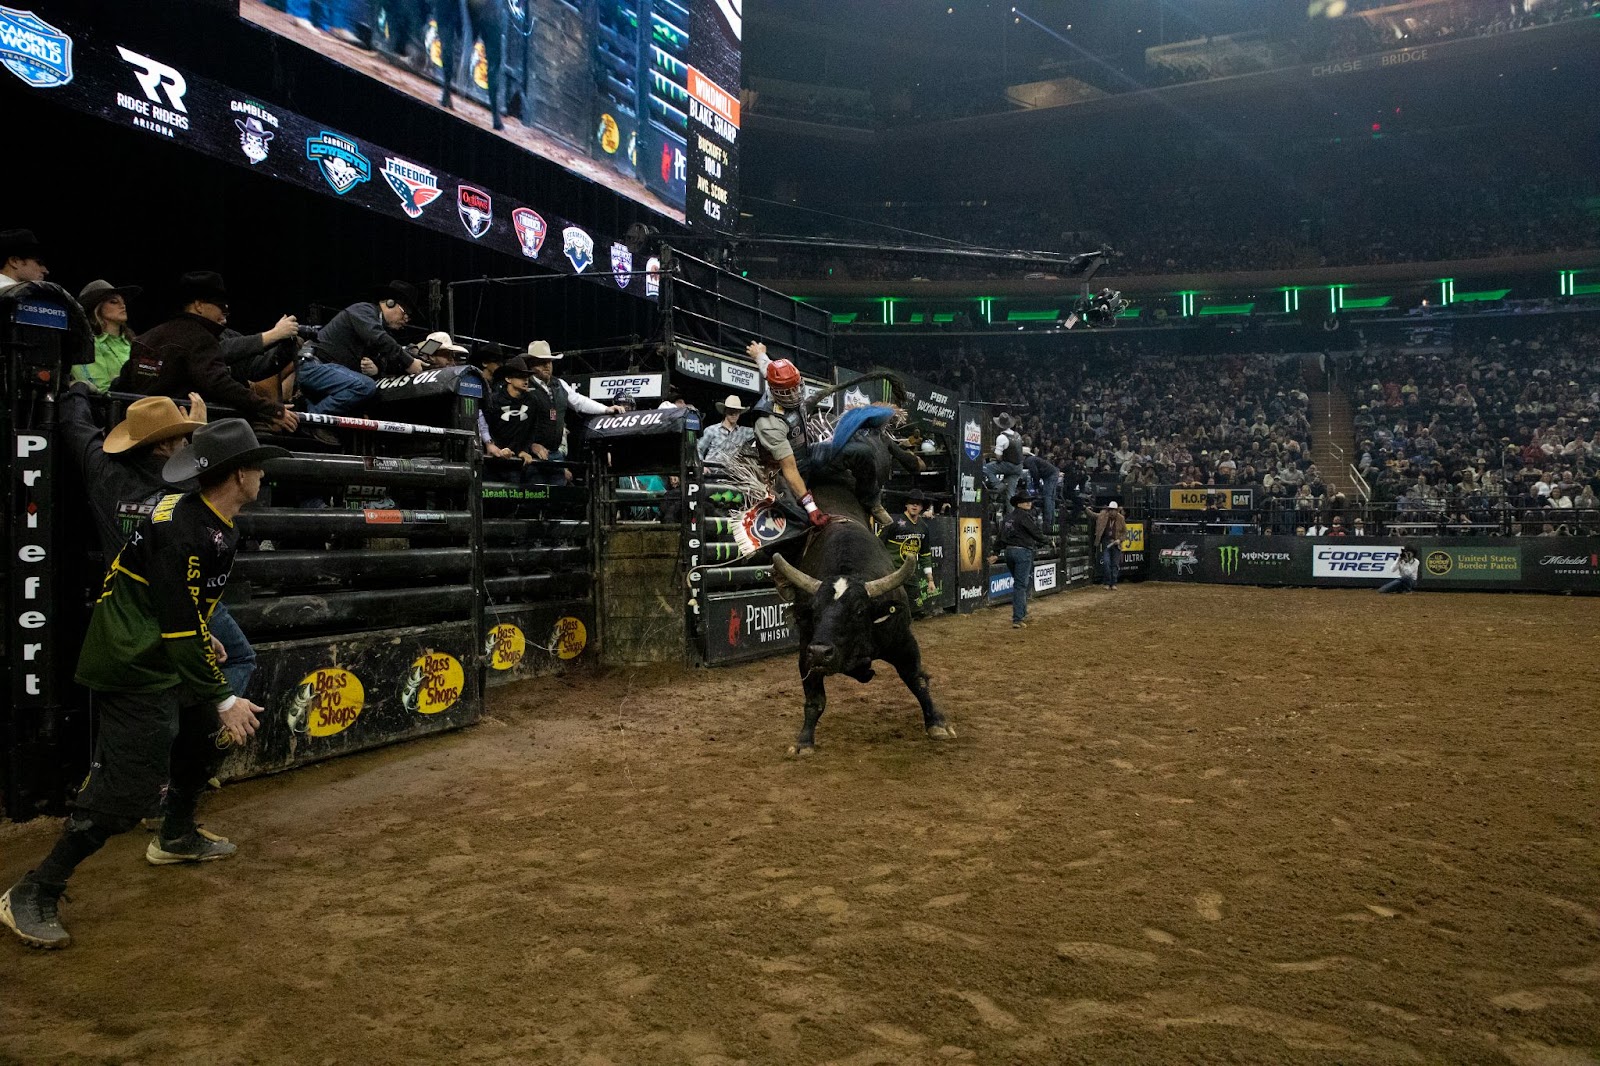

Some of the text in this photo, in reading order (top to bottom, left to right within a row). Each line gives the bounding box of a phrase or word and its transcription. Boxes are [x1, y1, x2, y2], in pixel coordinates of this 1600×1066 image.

[0, 21, 61, 54] CAMPING
[0, 31, 62, 64] WORLD
[1312, 49, 1428, 77] CHASE BRIDGE
[694, 76, 733, 119] WINDMILL
[117, 92, 189, 130] RIDGE RIDERS
[231, 100, 279, 128] GAMBLERS
[133, 116, 174, 138] ARIZONA
[689, 98, 737, 144] BLAKE SHARP
[323, 135, 356, 153] CAROLINA
[698, 134, 722, 162] BUCKOFF
[388, 161, 434, 187] FREEDOM
[704, 155, 721, 178] 100.0
[711, 184, 728, 204] SCORE
[704, 198, 721, 220] 41.25
[23, 304, 66, 317] CBS SPORTS
[677, 349, 716, 377] Priefert
[413, 370, 438, 385] OIL
[728, 366, 753, 380] COOPER
[731, 375, 750, 386] TIRES
[601, 378, 650, 388] COOPER
[930, 391, 948, 404] PBR
[341, 416, 363, 426] LUCAS
[594, 412, 662, 430] LUCAS OIL
[1232, 494, 1250, 505] CAT
[963, 526, 979, 534] ARIAT
[1124, 554, 1144, 563] ULTRA
[1241, 551, 1290, 560] MONSTER
[1318, 551, 1399, 561] COOPER
[1458, 554, 1517, 563] United States
[1539, 555, 1589, 566] Michelob
[17, 434, 48, 695] Priefert
[186, 555, 200, 581] U.S.
[1036, 566, 1055, 578] COOPER
[1328, 562, 1386, 572] TIRES
[1458, 562, 1518, 570] Border Patrol
[1038, 577, 1052, 587] TIRES
[562, 619, 578, 630] Bass
[746, 603, 794, 635] PENDLE
[496, 626, 516, 639] Bass
[563, 631, 575, 640] Pro
[760, 627, 790, 643] WHISKY
[499, 639, 512, 650] Pro
[562, 641, 583, 653] Shops
[423, 656, 450, 674] Bass
[497, 650, 521, 664] Shops
[315, 671, 348, 692] Bass
[425, 671, 445, 689] Pro
[316, 690, 341, 708] Pro
[425, 686, 459, 706] Shops
[317, 704, 358, 728] Shops
